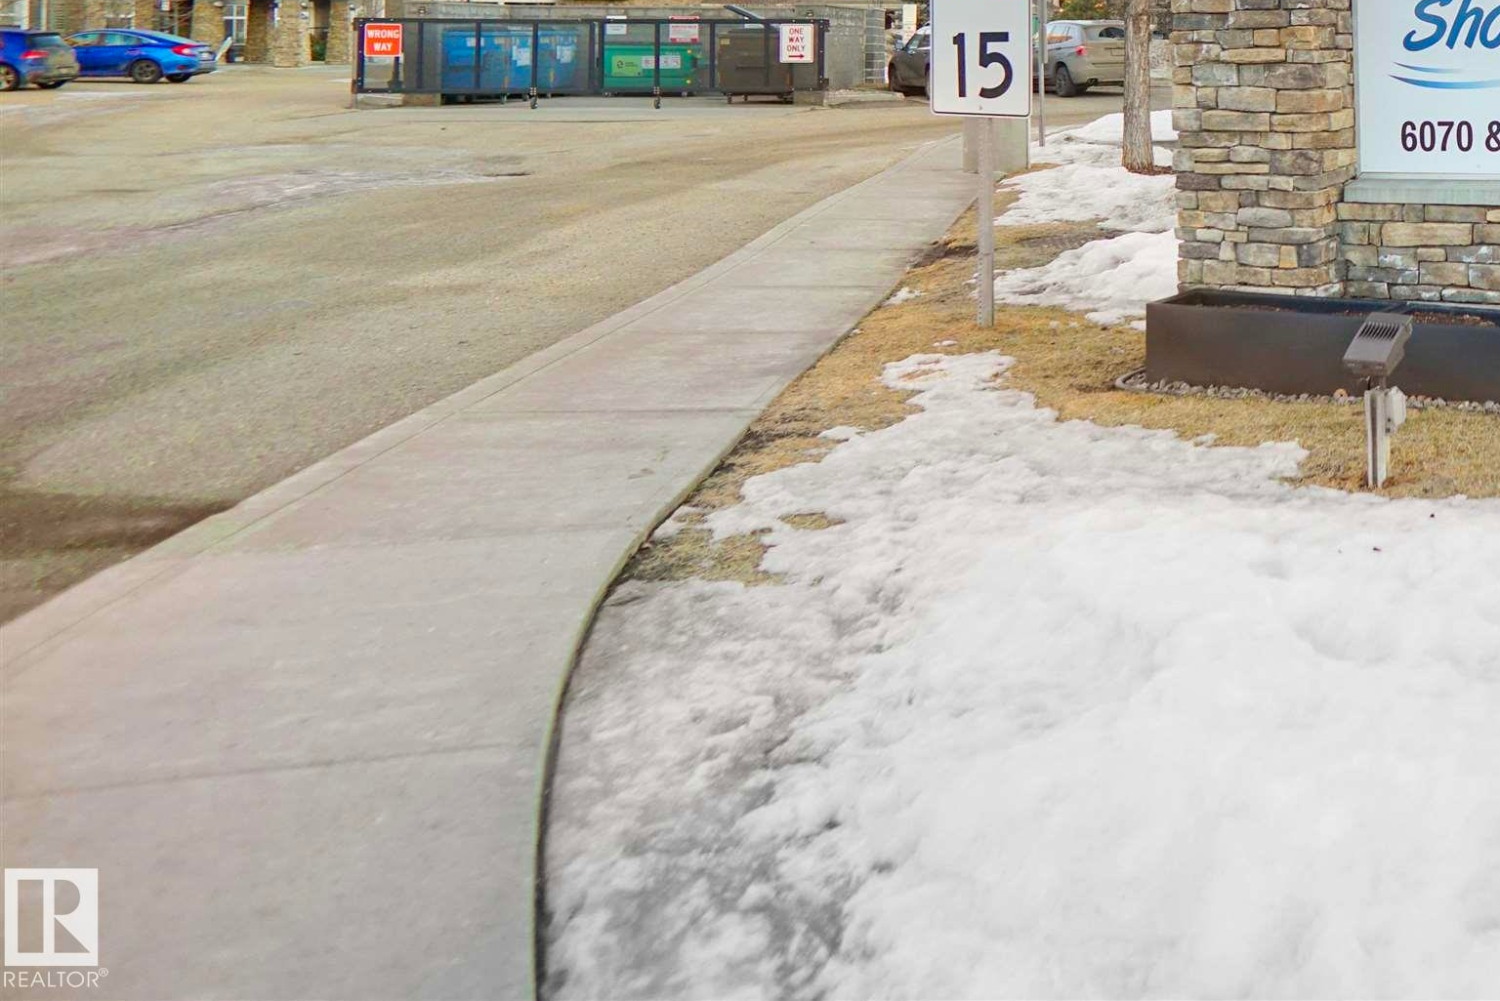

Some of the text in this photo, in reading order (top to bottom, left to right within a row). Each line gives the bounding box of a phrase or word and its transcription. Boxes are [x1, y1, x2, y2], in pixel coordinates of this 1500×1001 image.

[367, 29, 400, 39] WRONG
[373, 42, 392, 51] WAY
[952, 31, 1013, 99] 15
[1400, 120, 1474, 152] 6070
